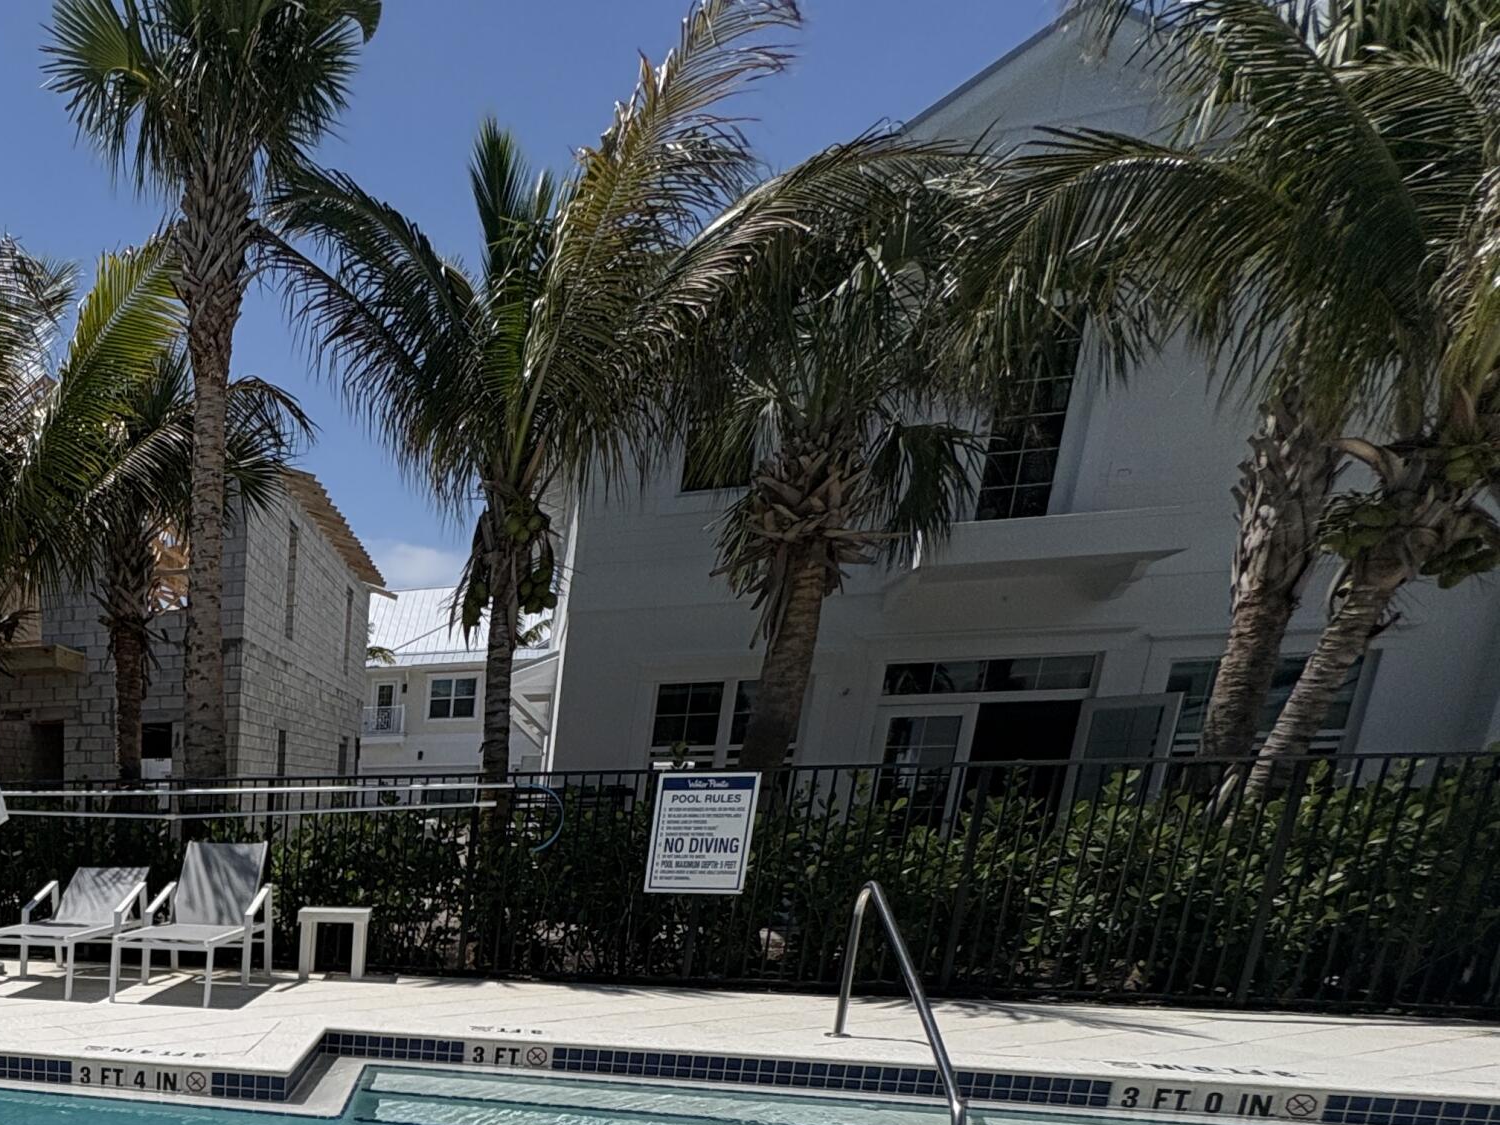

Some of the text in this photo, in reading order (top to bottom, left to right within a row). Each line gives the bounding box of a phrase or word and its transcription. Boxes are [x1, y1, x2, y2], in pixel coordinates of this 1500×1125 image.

[671, 794, 742, 803] POOL RULES
[663, 837, 740, 854] NO DIVING
[472, 1046, 485, 1063] 3
[80, 1066, 91, 1084] 3
[133, 1070, 146, 1089] 4
[1121, 1087, 1140, 1109] 3
[1203, 1092, 1224, 1114] 0
